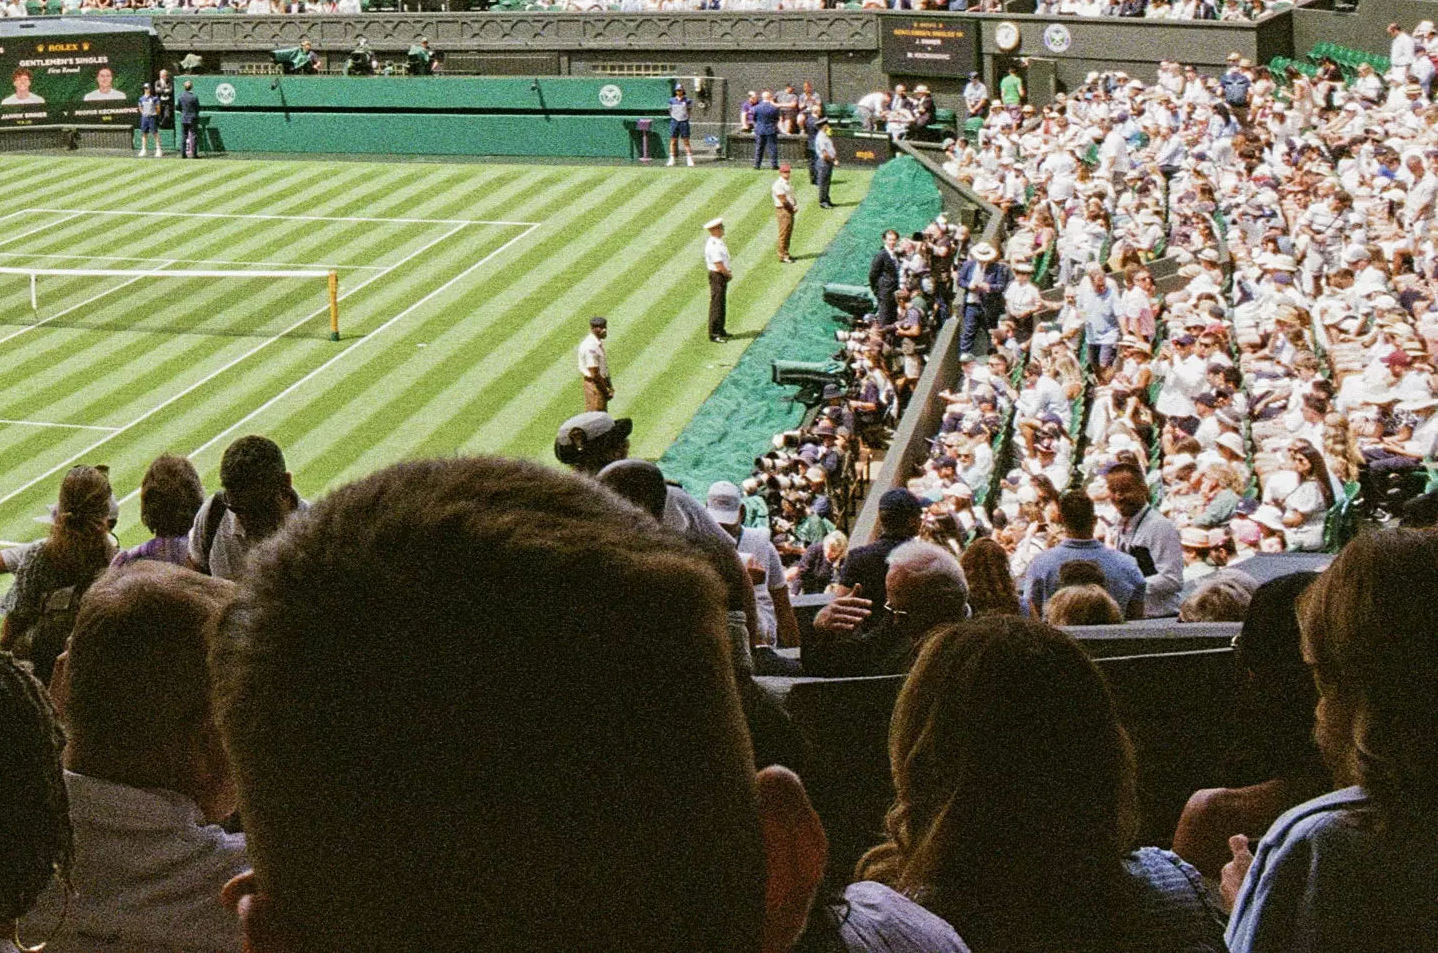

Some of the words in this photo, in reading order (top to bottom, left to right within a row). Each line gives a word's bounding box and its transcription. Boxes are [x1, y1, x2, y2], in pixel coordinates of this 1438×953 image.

[48, 43, 78, 52] ROLEX
[19, 57, 74, 67] GENTLEMEN'S
[75, 55, 108, 65] SINGLES
